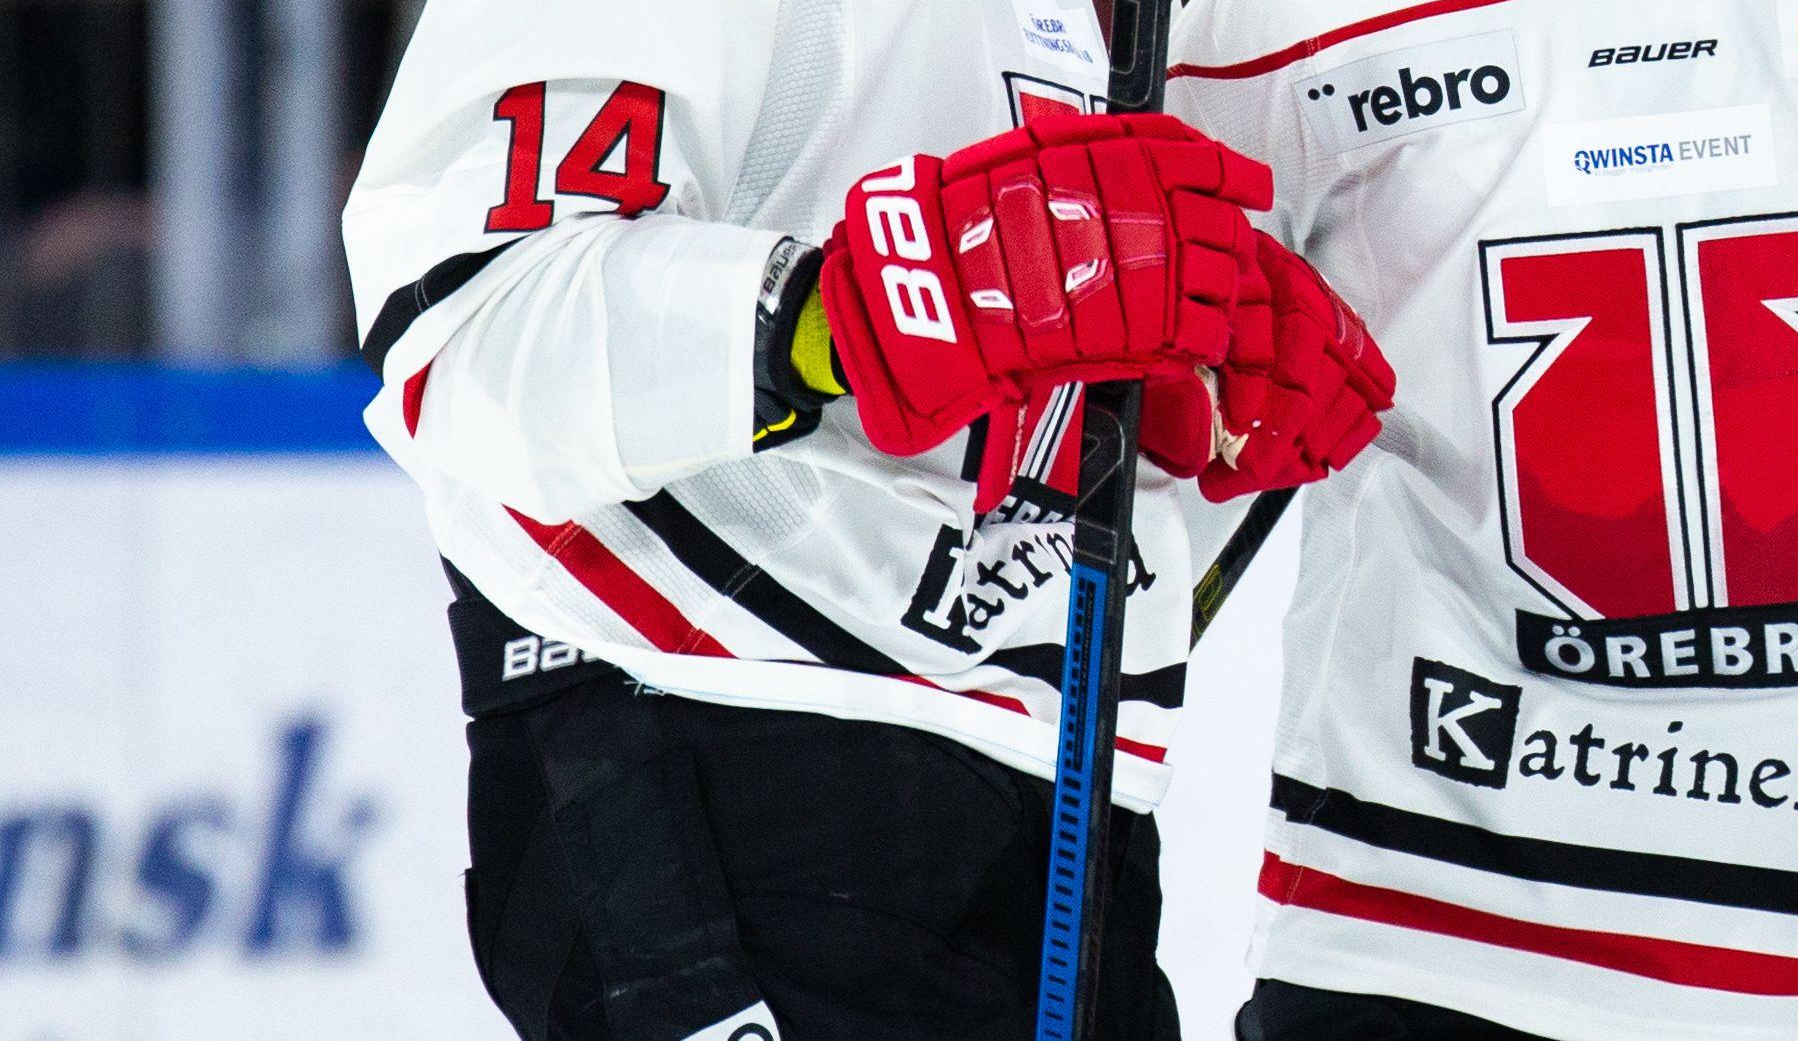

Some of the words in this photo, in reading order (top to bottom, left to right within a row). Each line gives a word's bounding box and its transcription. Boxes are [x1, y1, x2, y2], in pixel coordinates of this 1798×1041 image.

[1587, 39, 1719, 68] BAUER
[485, 79, 671, 236] 14
[1573, 143, 1674, 176] QWINSTA
[1679, 135, 1752, 161] EVENT
[861, 156, 957, 344] BAU
